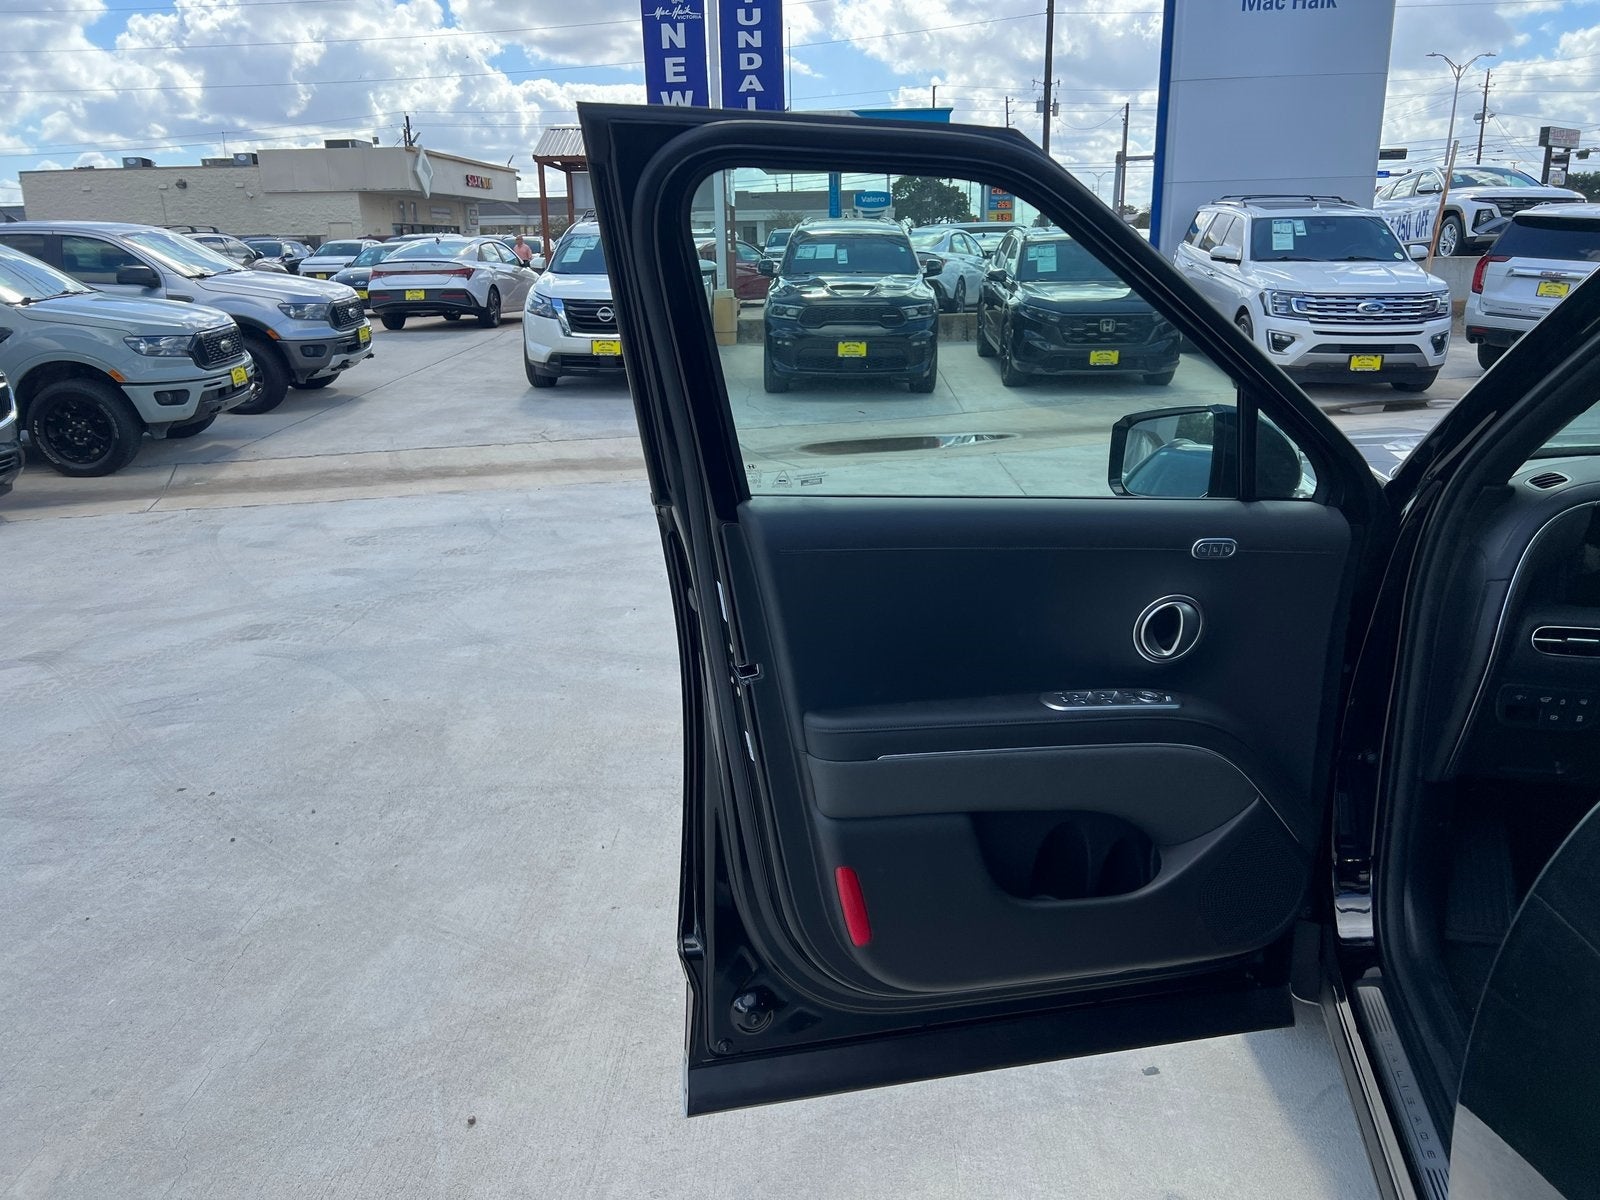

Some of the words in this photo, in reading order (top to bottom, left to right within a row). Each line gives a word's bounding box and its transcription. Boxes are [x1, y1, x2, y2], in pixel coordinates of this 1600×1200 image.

[1241, 0, 1286, 12] Mac
[1292, 0, 1338, 10] Haik
[737, 0, 764, 111] UNDAI
[1415, 209, 1430, 238] OFF
[1385, 1041, 1437, 1160] PALISADE
